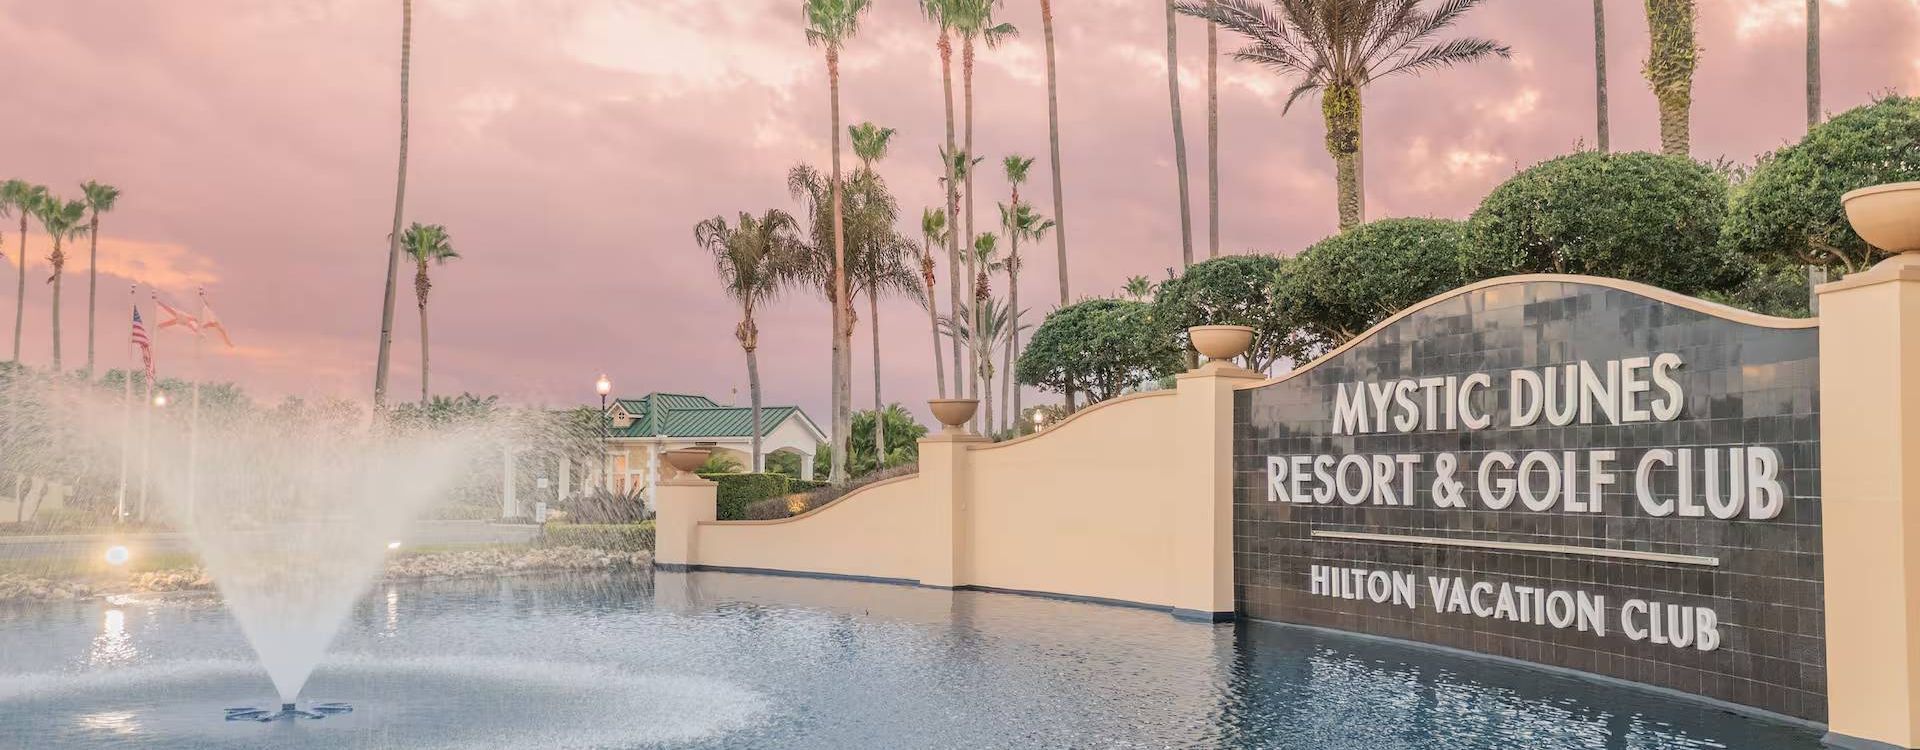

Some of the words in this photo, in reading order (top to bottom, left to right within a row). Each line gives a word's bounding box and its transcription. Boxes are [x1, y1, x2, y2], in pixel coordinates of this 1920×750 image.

[1332, 372, 1492, 435] MYSTIC
[1510, 352, 1685, 427] DUNES
[1267, 452, 1421, 506] RESORT
[1431, 452, 1467, 508] &
[1477, 448, 1616, 513] GOLF
[1635, 446, 1785, 520] CLUB
[1310, 564, 1416, 610] HILTON
[1427, 576, 1606, 637] VACATION
[1621, 599, 1721, 652] CLUB
